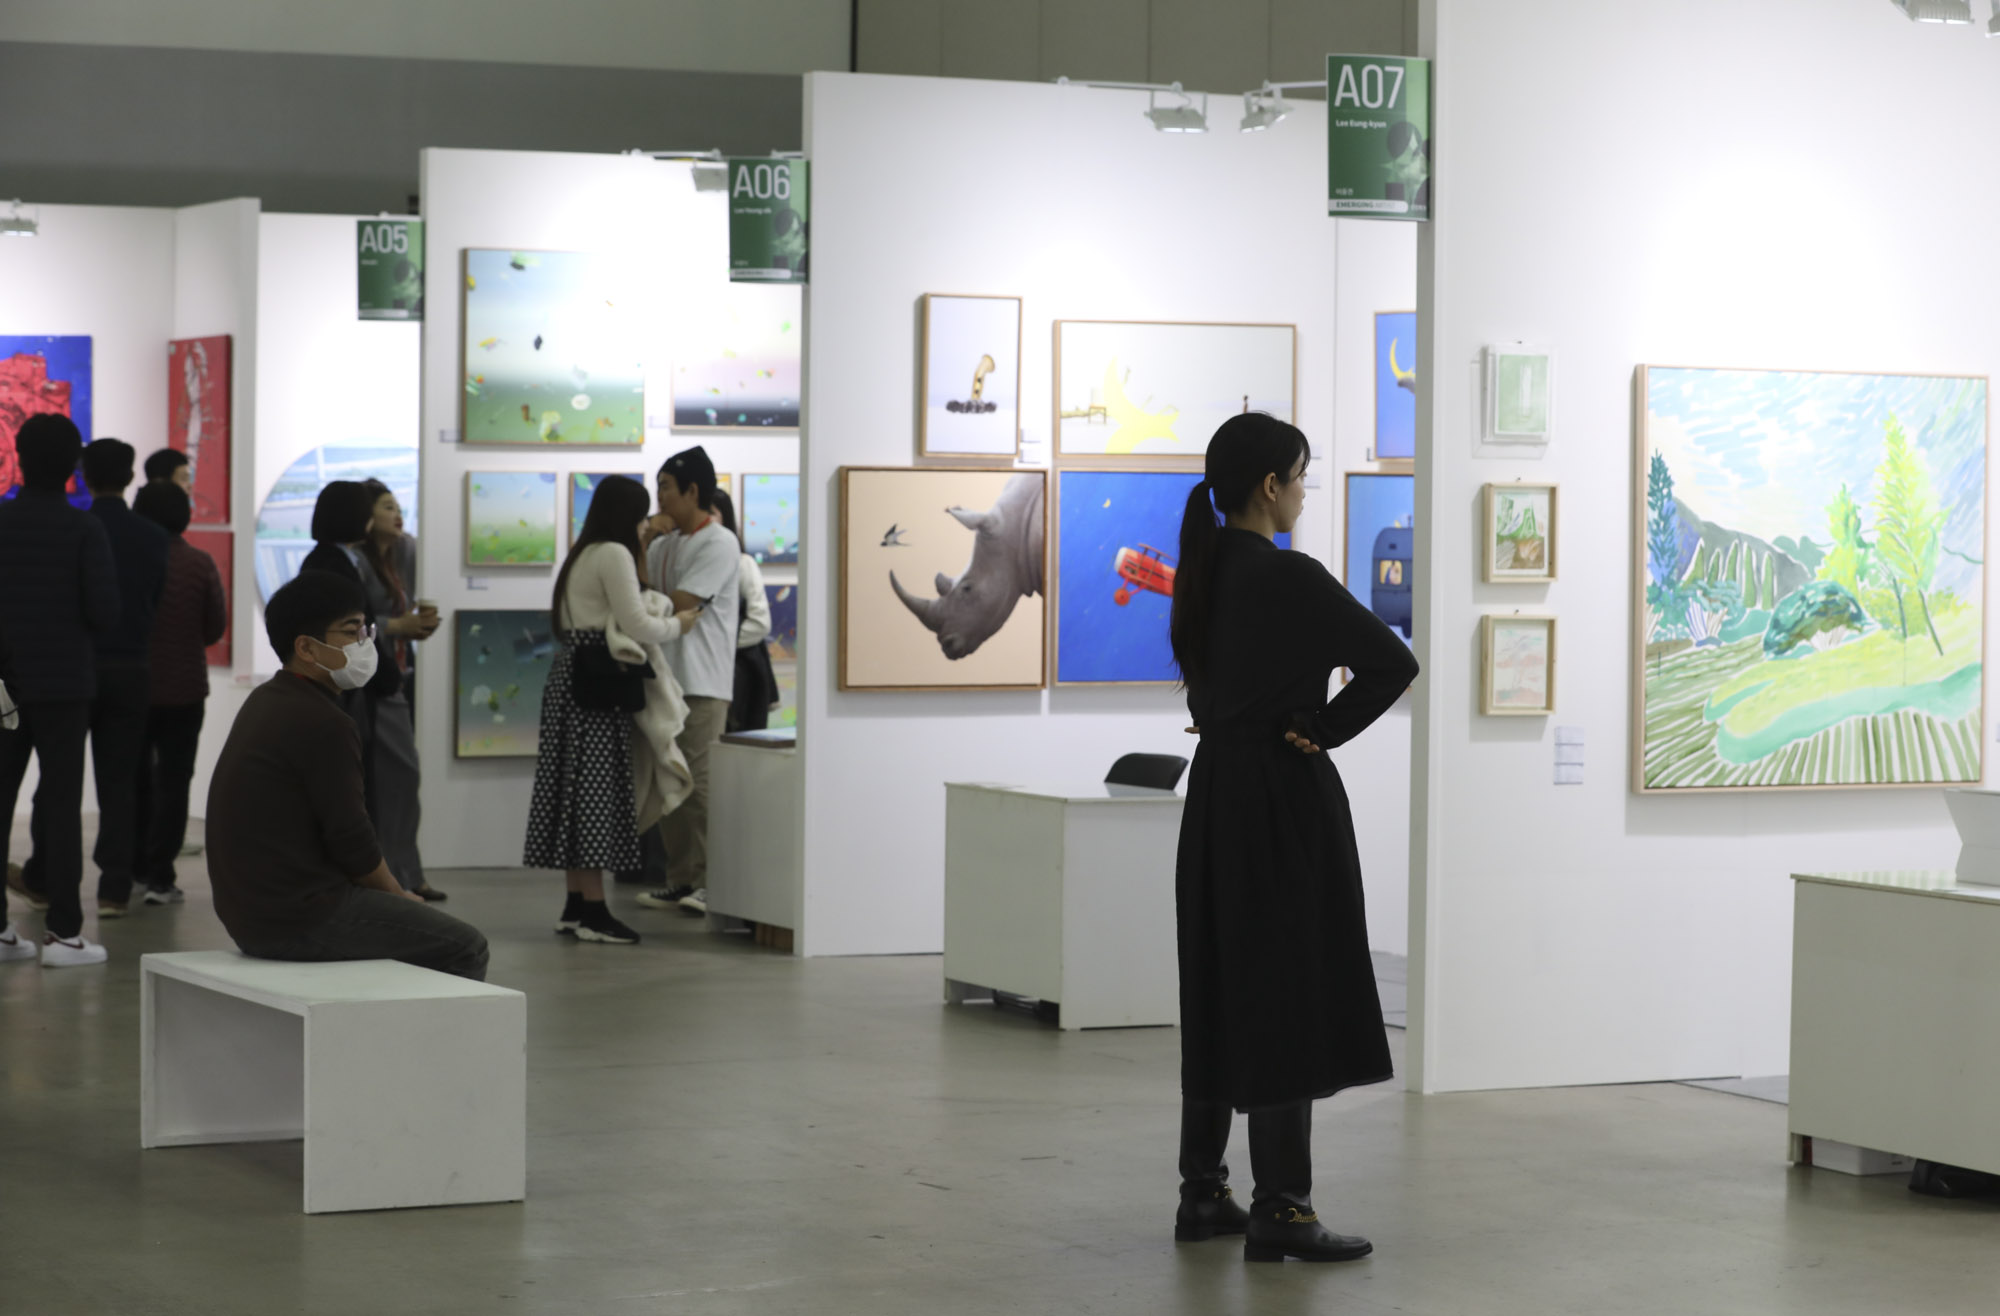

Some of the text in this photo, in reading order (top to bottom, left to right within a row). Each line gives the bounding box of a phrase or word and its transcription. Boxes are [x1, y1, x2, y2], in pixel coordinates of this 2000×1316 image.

[1334, 63, 1405, 110] A07
[733, 164, 791, 200] A06
[360, 223, 409, 254] A05
